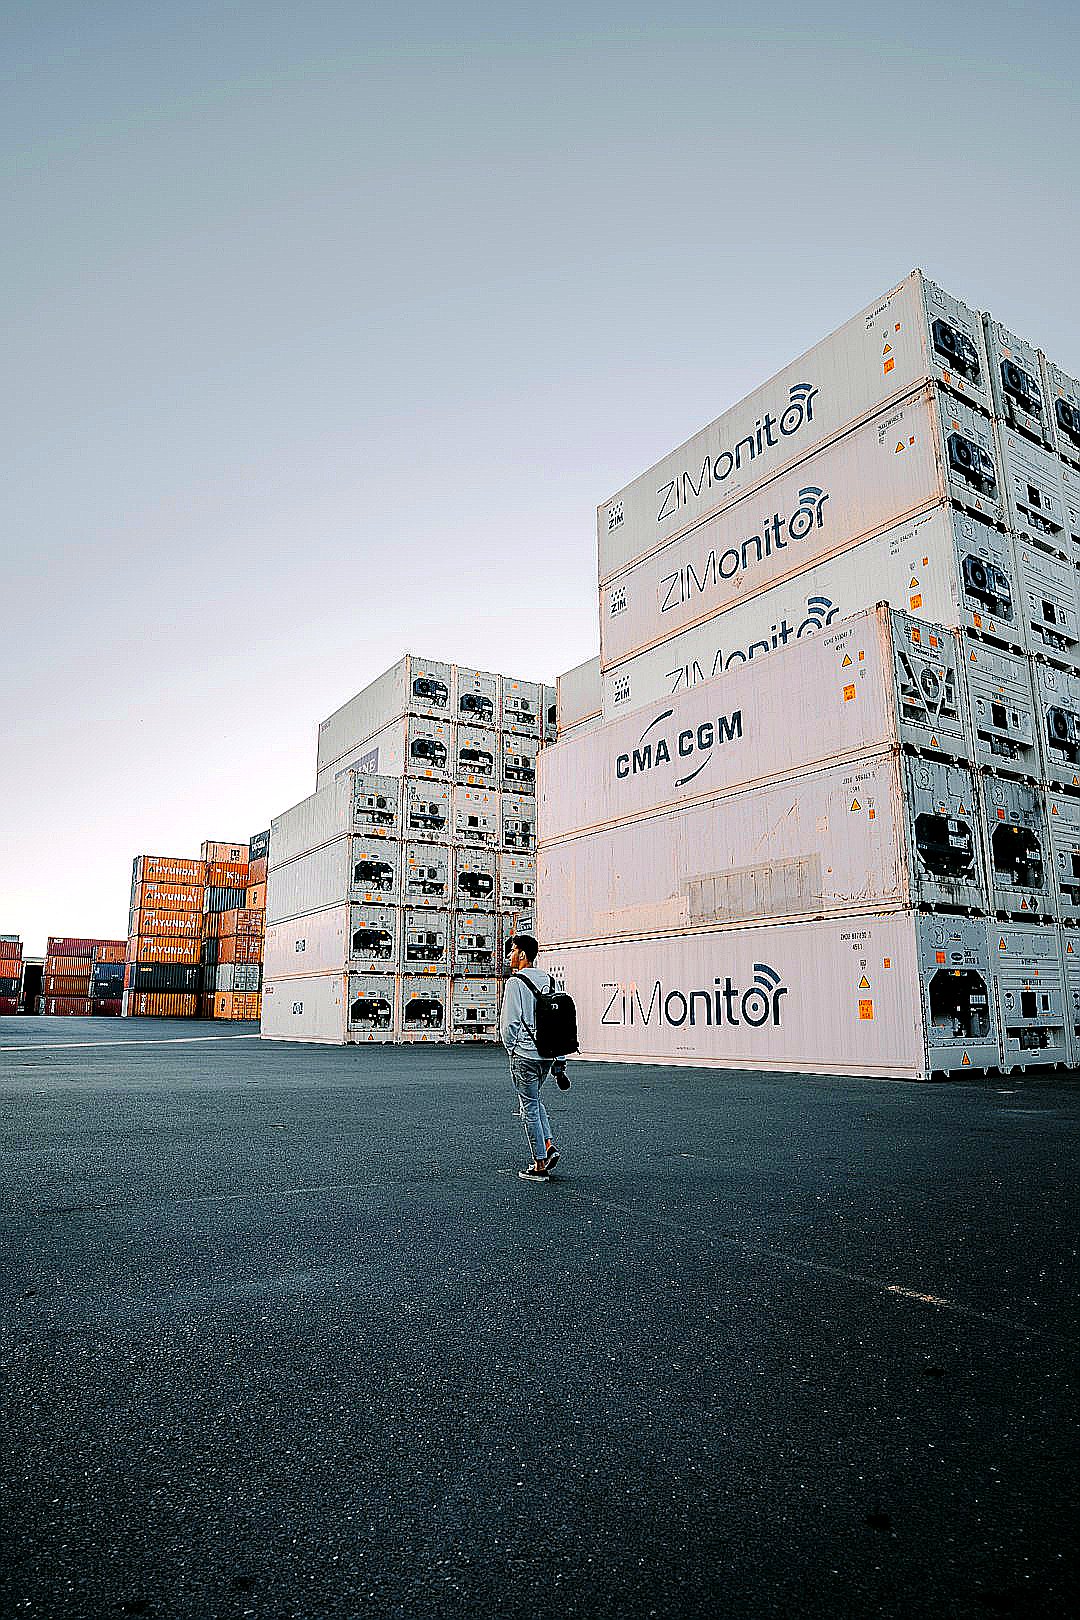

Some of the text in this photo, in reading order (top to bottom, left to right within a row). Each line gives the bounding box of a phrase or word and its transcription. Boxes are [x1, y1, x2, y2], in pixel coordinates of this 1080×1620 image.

[657, 383, 818, 522] ZIMonitor
[608, 511, 624, 530] ZIM
[660, 486, 829, 613] ZIMonitor
[610, 597, 627, 614] ZIM
[614, 686, 630, 703] ZIM
[616, 710, 743, 779] CMA CGM
[153, 892, 197, 903] HYUNDAI
[151, 918, 196, 929] HYUNDAI
[150, 945, 194, 955] HYUNDAI
[601, 963, 788, 1027] ZIMonitor
